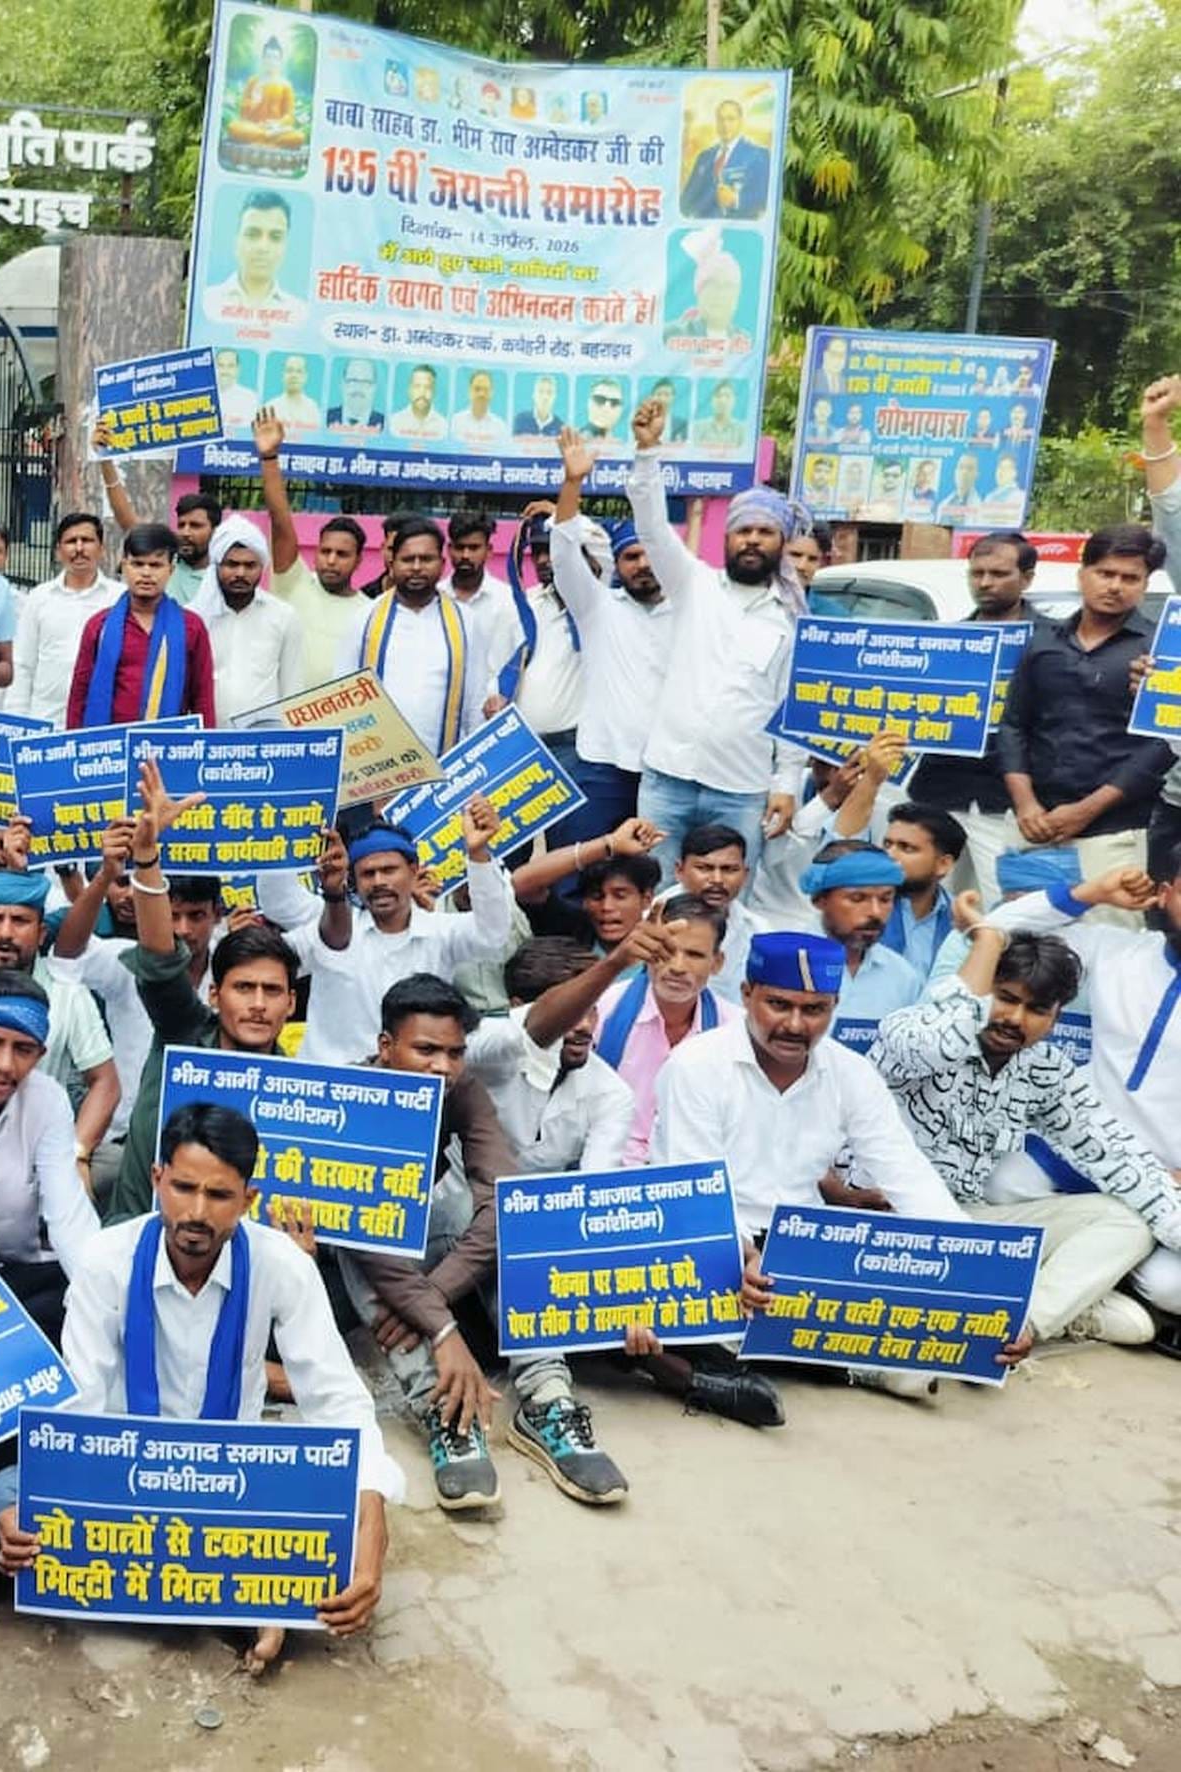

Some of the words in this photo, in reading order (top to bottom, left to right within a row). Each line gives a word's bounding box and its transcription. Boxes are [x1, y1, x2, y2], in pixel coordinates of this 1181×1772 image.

[64, 119, 155, 172] पार्क
[325, 99, 363, 128] बाबा
[369, 108, 414, 137] साहब
[453, 119, 481, 152] भीम
[490, 130, 516, 155] राव
[606, 136, 629, 165] जी
[638, 134, 665, 165] की
[322, 146, 377, 195] 135
[430, 165, 530, 220] जयन्ती
[540, 176, 662, 227] समारोह
[318, 264, 380, 303] हार्दिक
[285, 676, 380, 728] प्रधानमंत्री
[168, 739, 205, 760] आर्मी
[208, 745, 257, 760] आजाद
[260, 745, 305, 760] समाज
[309, 737, 339, 756] पार्टी
[172, 1060, 209, 1087] भीम
[213, 1067, 262, 1092] आर्मी
[263, 1076, 327, 1100] आजाद
[330, 1082, 389, 1107] समाज
[394, 1086, 435, 1112] पार्टी
[250, 1095, 347, 1134] (कांशीराम)
[273, 1146, 305, 1184] की
[310, 1156, 377, 1194] सरकार
[503, 1187, 539, 1215] भीम
[543, 1184, 585, 1212] आर्मी
[589, 1186, 643, 1208] आजाद
[646, 1182, 692, 1202] समाज
[695, 1169, 726, 1195] पार्टी
[579, 1204, 665, 1241] (कांशीराम)
[777, 1213, 818, 1241] भीम
[821, 1221, 871, 1245] आर्मी
[871, 1229, 935, 1251] आजाद
[937, 1236, 995, 1257] समाज
[998, 1235, 1038, 1260] पार्टी
[854, 1248, 950, 1283] (कांशीराम)
[540, 1304, 571, 1336] लीक
[815, 1297, 842, 1322] पर
[844, 1298, 885, 1327] चली
[887, 1305, 963, 1334] एक-एक
[792, 1327, 821, 1350] का
[878, 1330, 916, 1360] देना
[29, 1423, 76, 1454] भीम
[81, 1431, 139, 1458] आर्मी
[142, 1438, 222, 1464] आजाद
[226, 1443, 298, 1466] समाज
[304, 1438, 351, 1468] पार्टी
[128, 1462, 247, 1500] (कांशीराम)
[33, 1507, 74, 1550] जो
[165, 1515, 193, 1558] से
[202, 1526, 337, 1569] टकराएगा,
[123, 1560, 154, 1602] में
[160, 1562, 224, 1604] मिल
